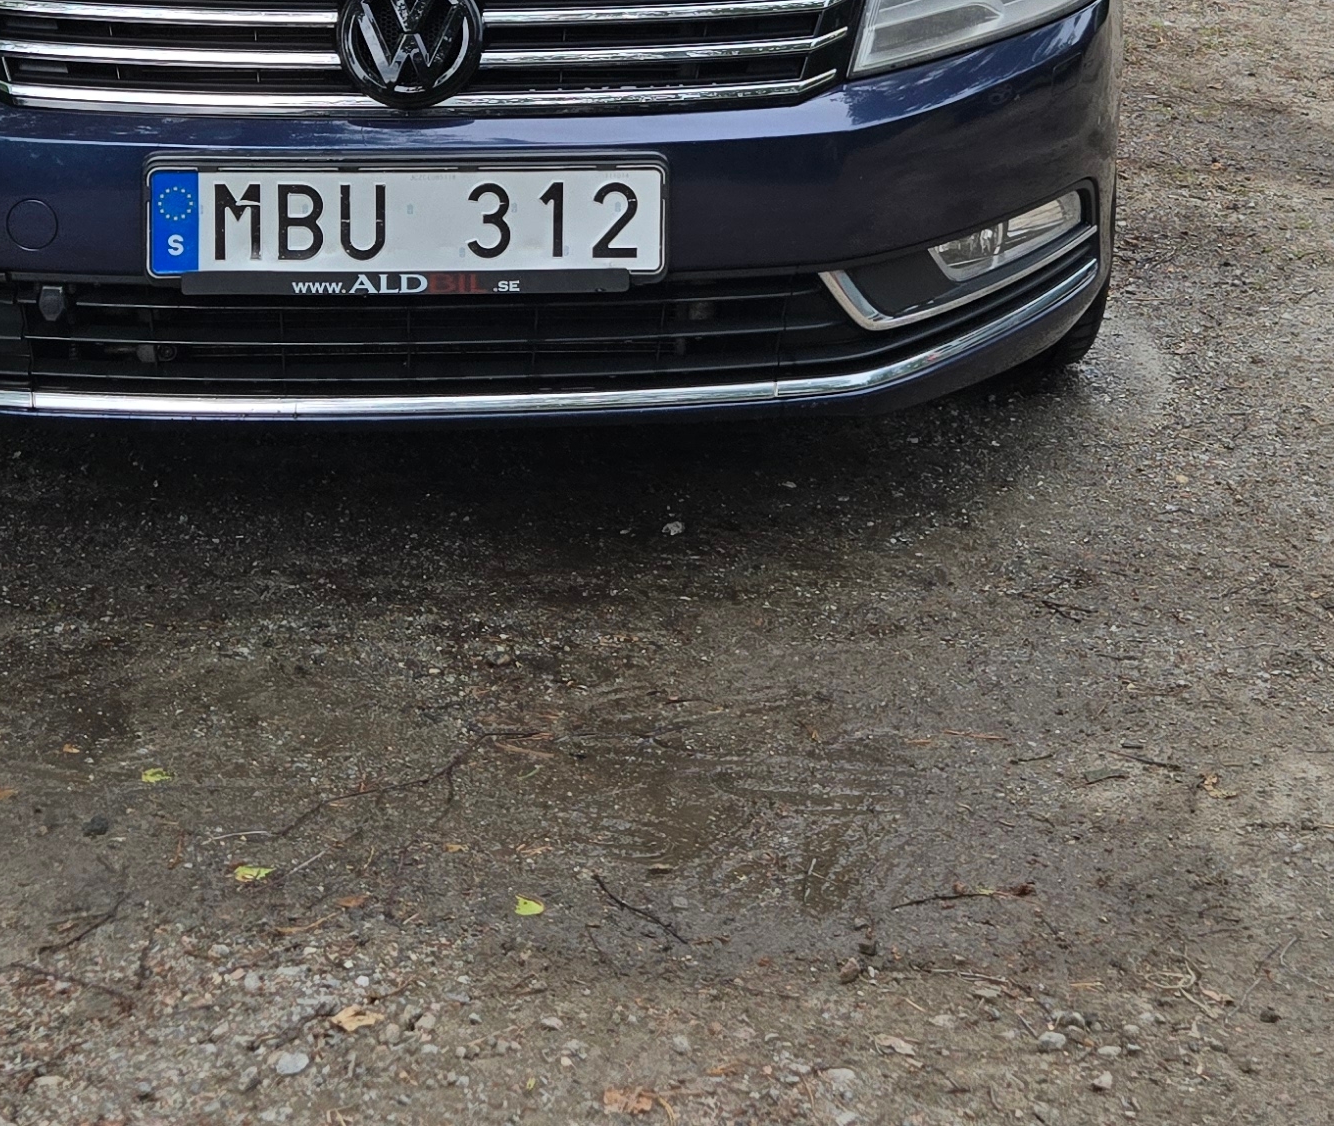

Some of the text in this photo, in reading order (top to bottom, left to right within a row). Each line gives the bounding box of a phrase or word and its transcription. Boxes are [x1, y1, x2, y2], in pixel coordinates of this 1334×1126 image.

[167, 234, 185, 256] S
[214, 181, 638, 261] MBU 312
